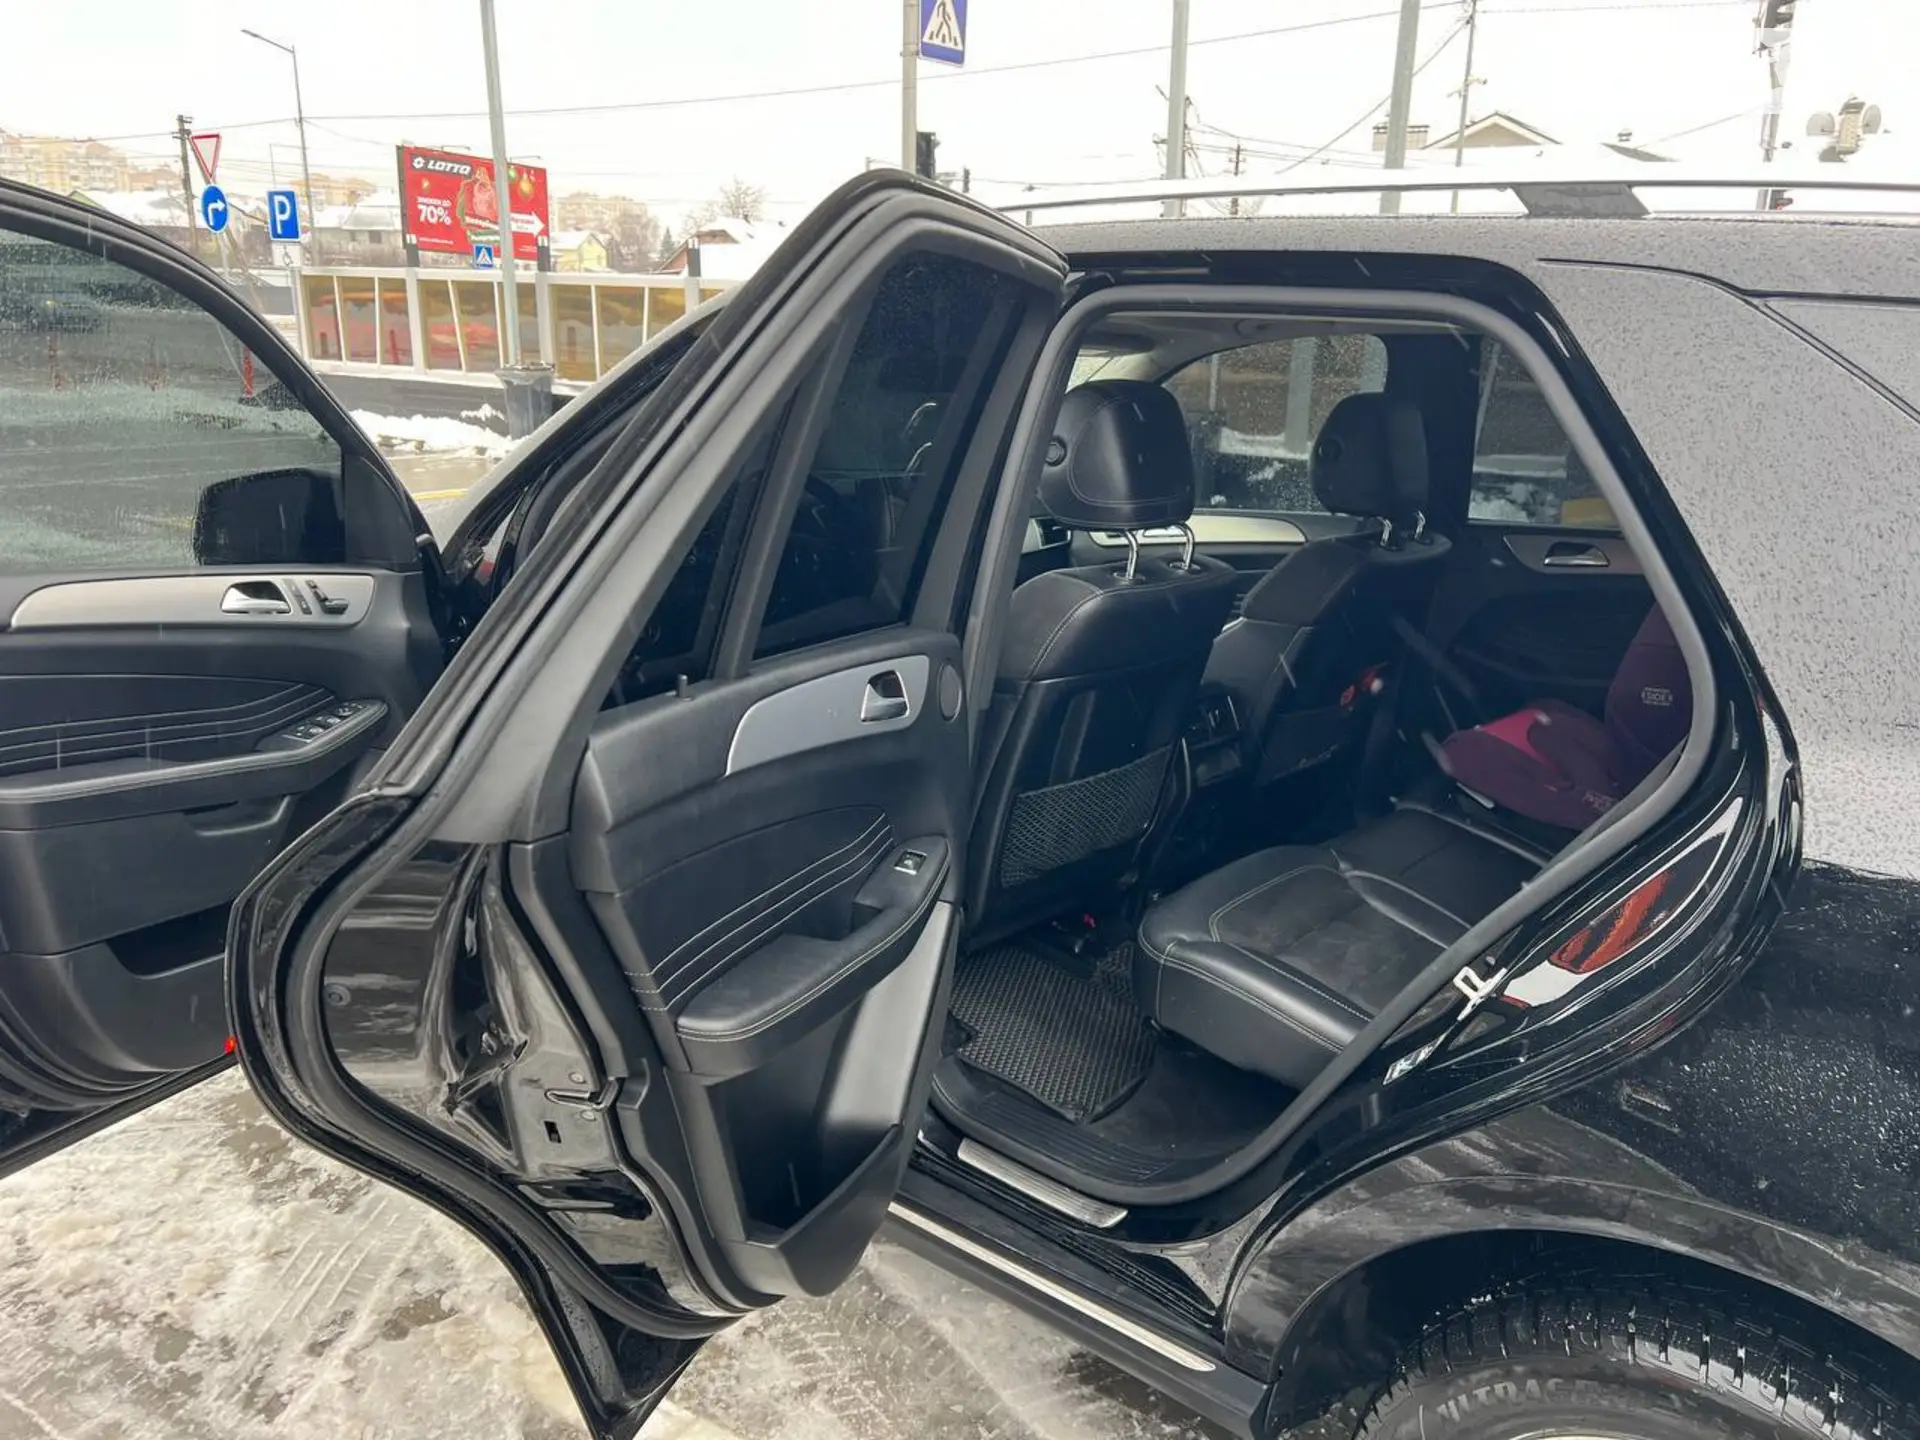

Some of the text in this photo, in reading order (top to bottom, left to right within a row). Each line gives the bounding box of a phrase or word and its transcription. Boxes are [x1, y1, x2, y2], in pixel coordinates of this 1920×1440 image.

[427, 160, 472, 176] LOTTO
[273, 194, 292, 235] P
[417, 204, 452, 226] 70%
